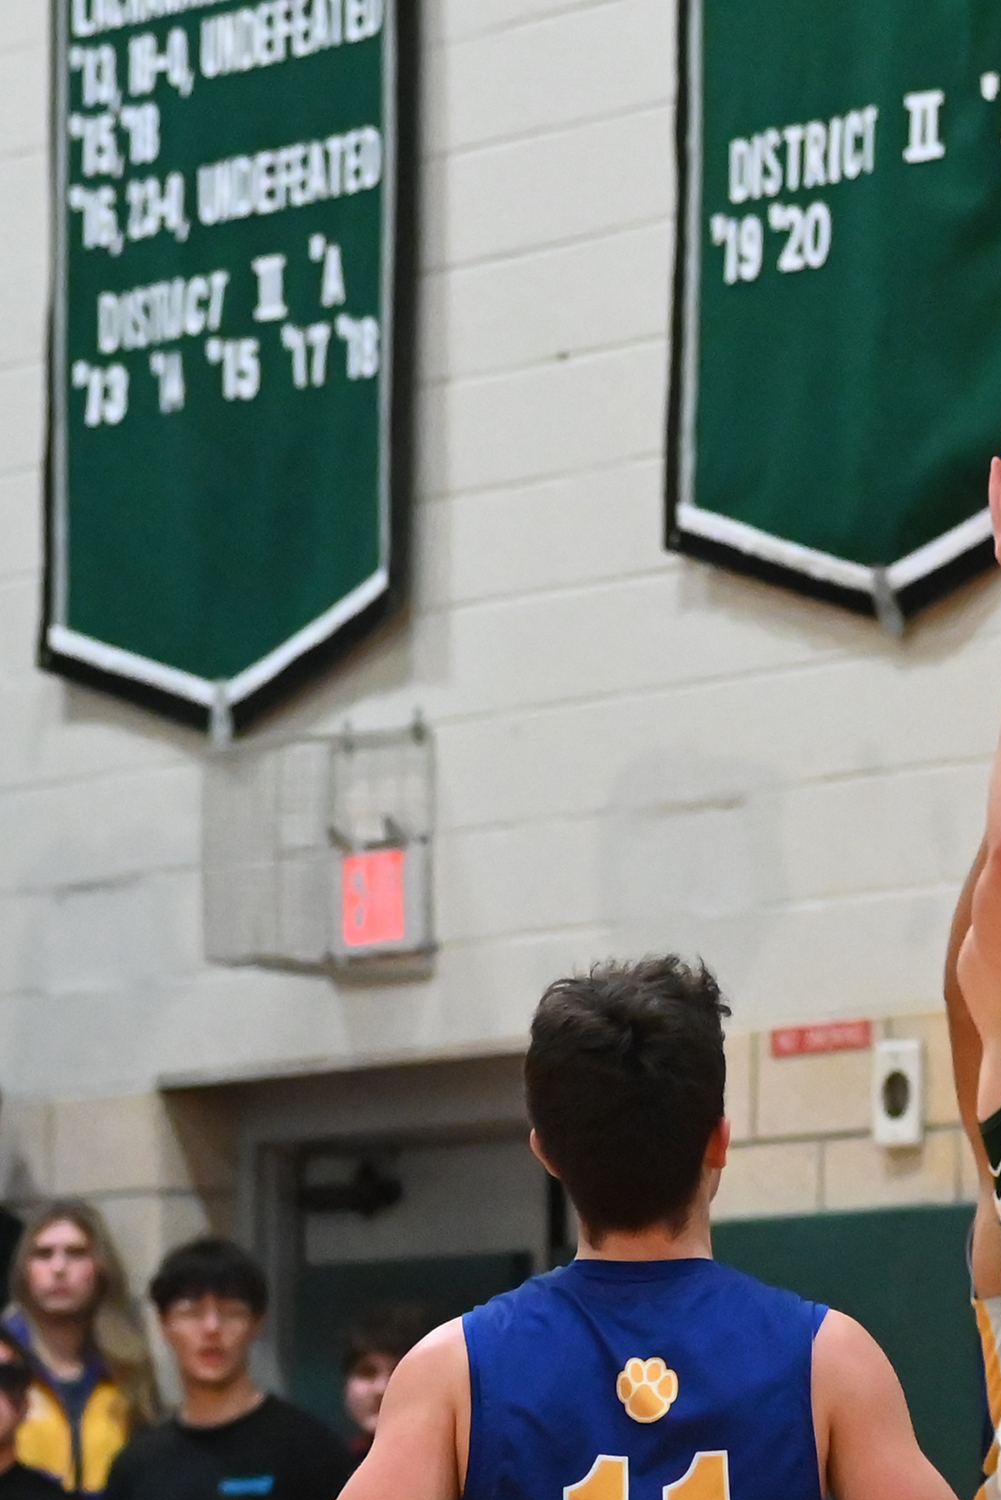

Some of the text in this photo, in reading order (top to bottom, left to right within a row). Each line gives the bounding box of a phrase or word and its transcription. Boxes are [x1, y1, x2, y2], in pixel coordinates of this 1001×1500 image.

[197, 125, 383, 225] UNDEFEATED
[728, 104, 878, 204] DISTRICT
[903, 89, 945, 164] II
[710, 201, 832, 285] '19 '20
